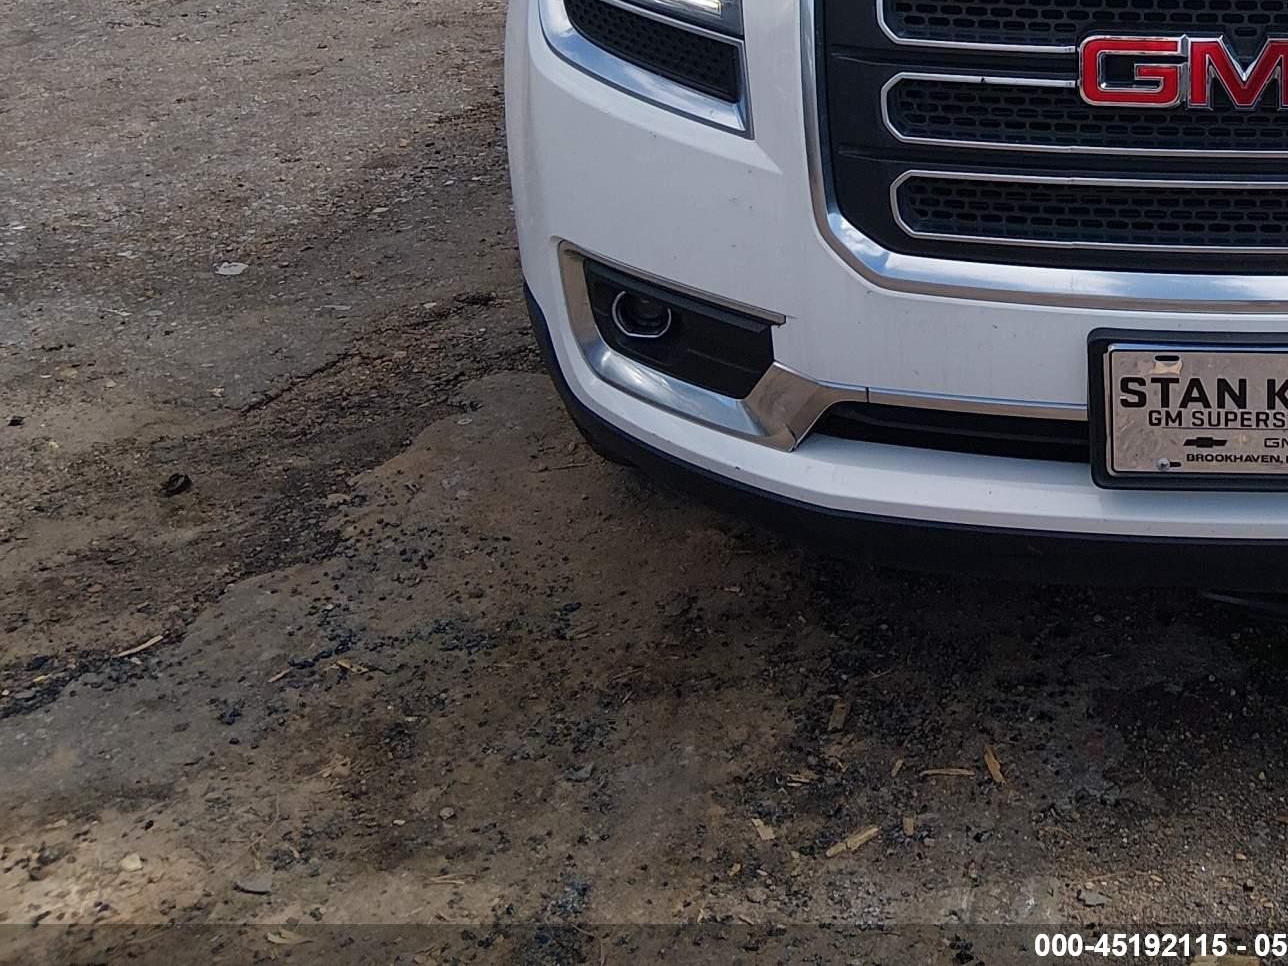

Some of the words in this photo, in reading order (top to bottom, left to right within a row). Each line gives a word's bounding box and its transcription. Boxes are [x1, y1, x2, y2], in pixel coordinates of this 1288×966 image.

[1119, 377, 1248, 410] STAN
[1148, 410, 1183, 427] GM
[1186, 453, 1284, 465] BROOKHAVEN,
